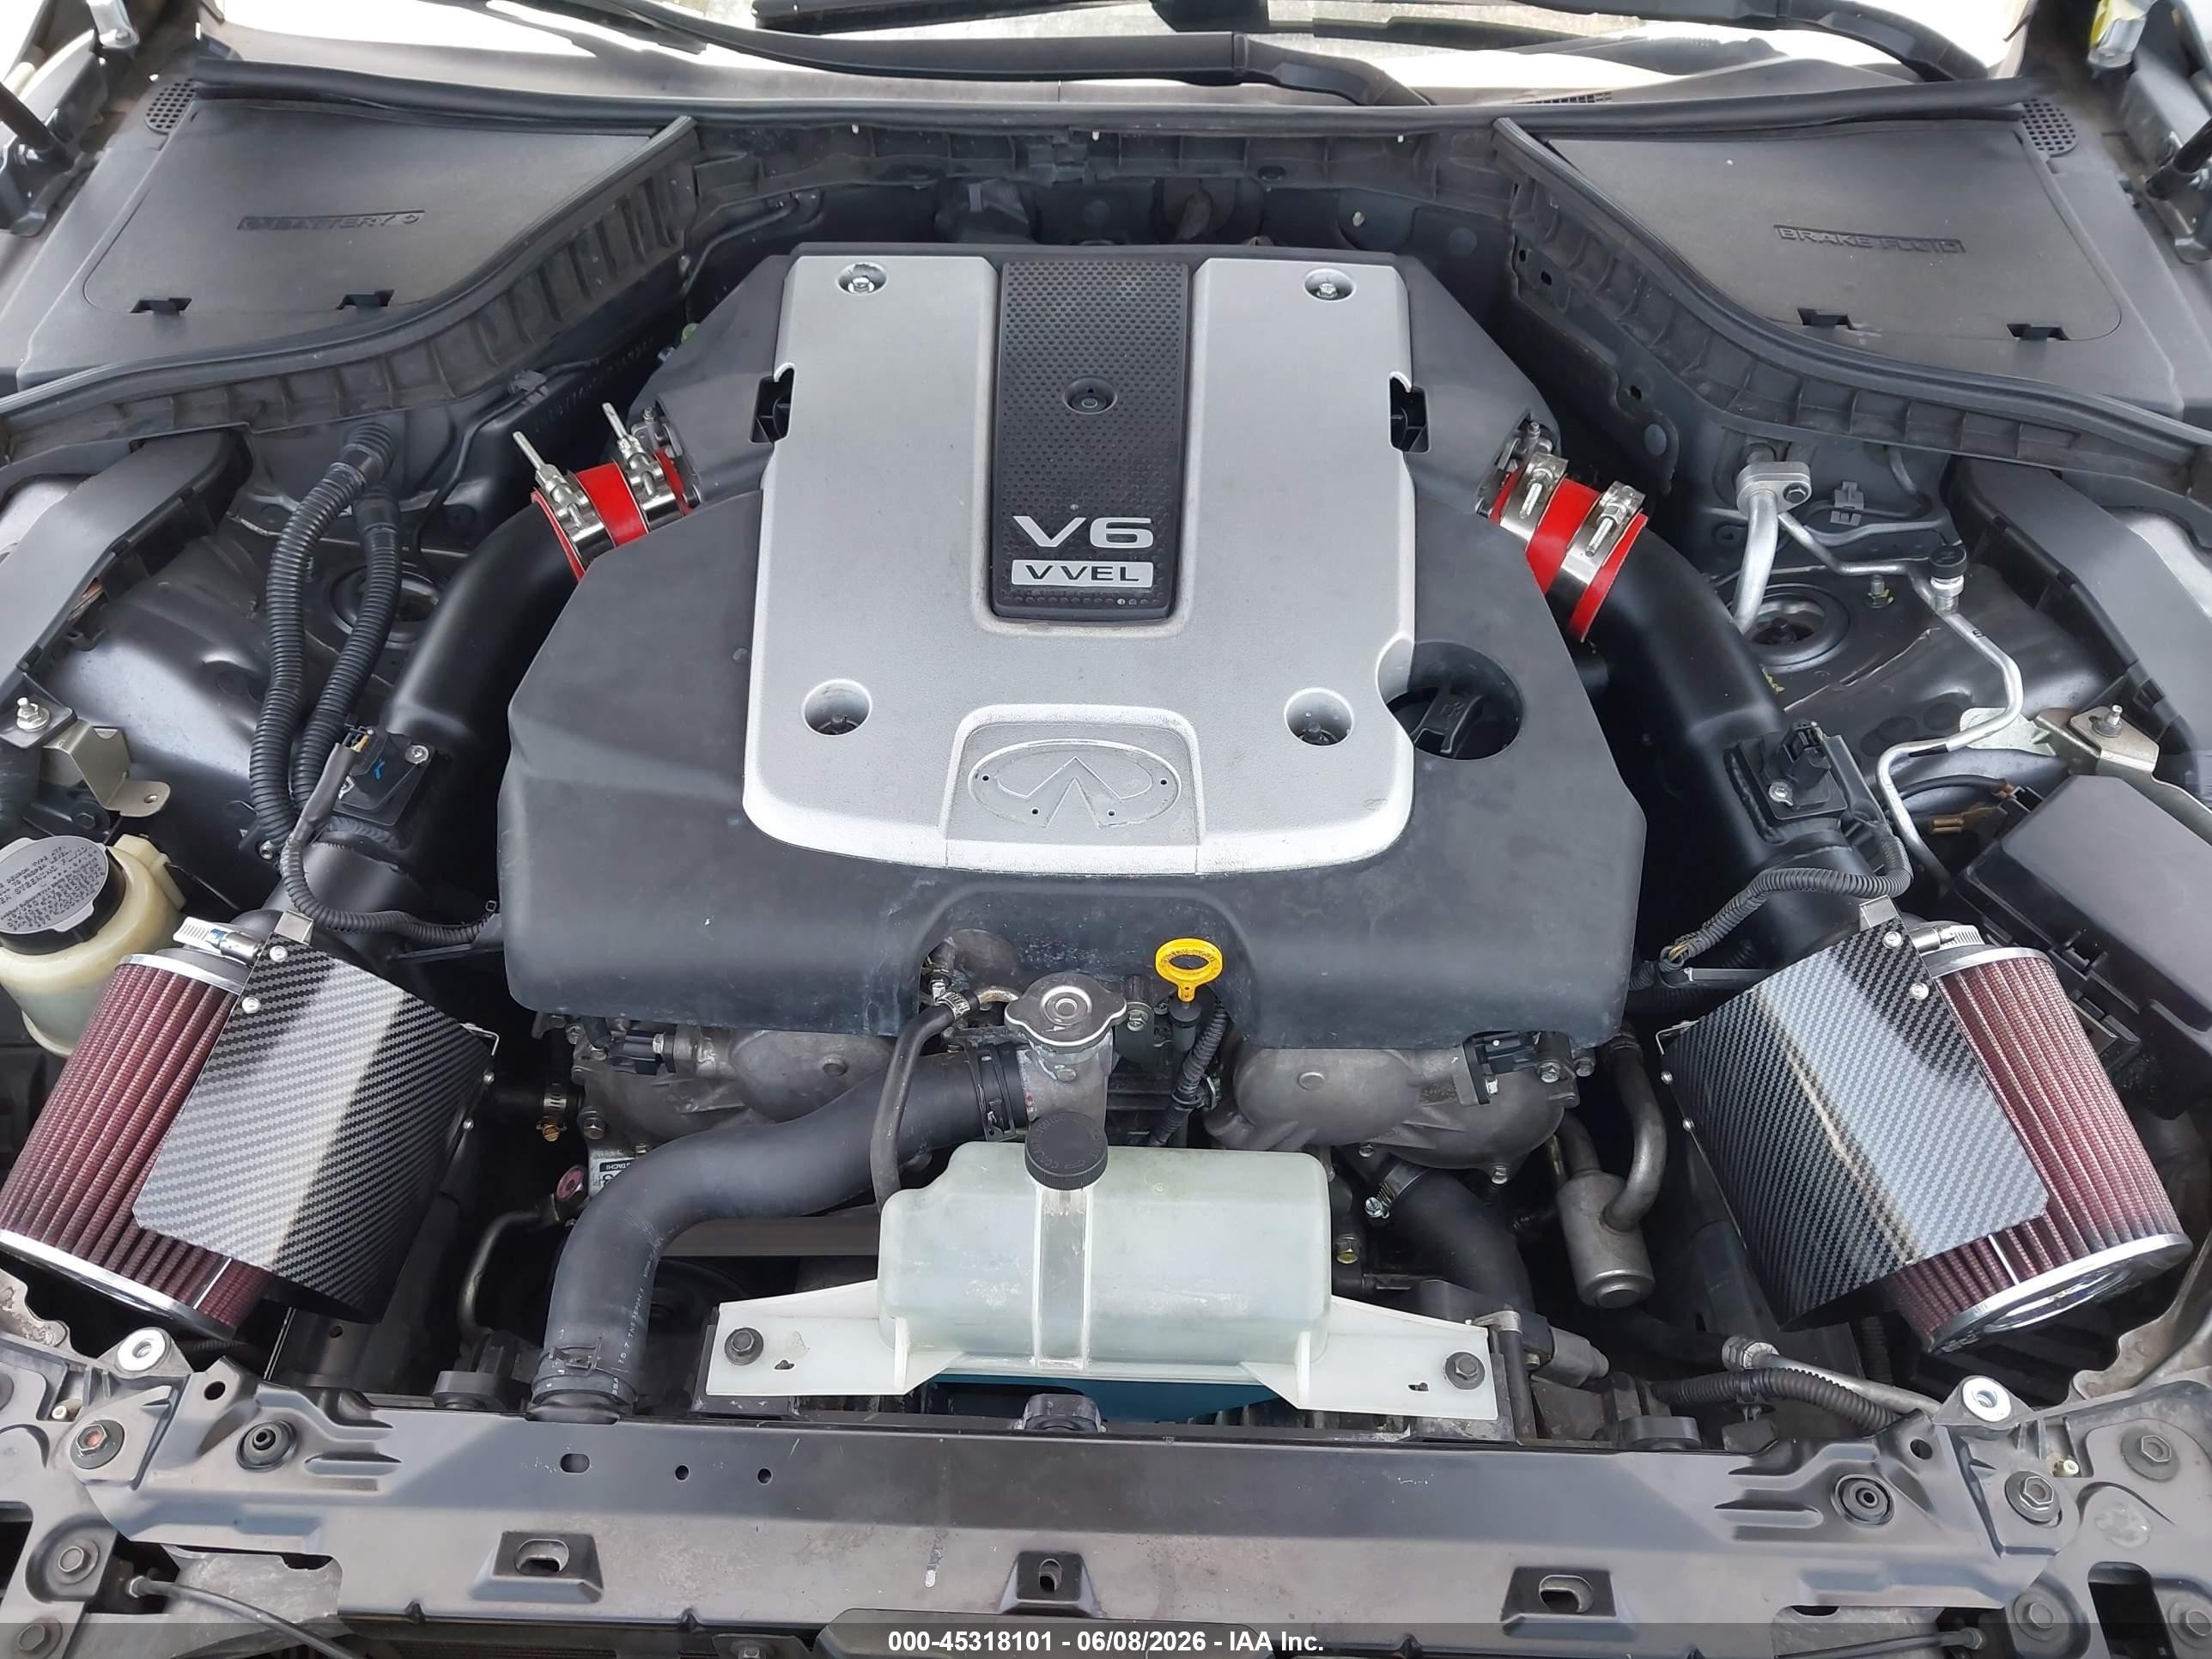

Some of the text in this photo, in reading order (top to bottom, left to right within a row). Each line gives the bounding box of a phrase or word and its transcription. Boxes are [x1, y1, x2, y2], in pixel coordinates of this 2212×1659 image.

[1778, 227, 1963, 253] BRAKE FLUID
[1012, 515, 1154, 549] V6
[1024, 564, 1140, 582] VVEL
